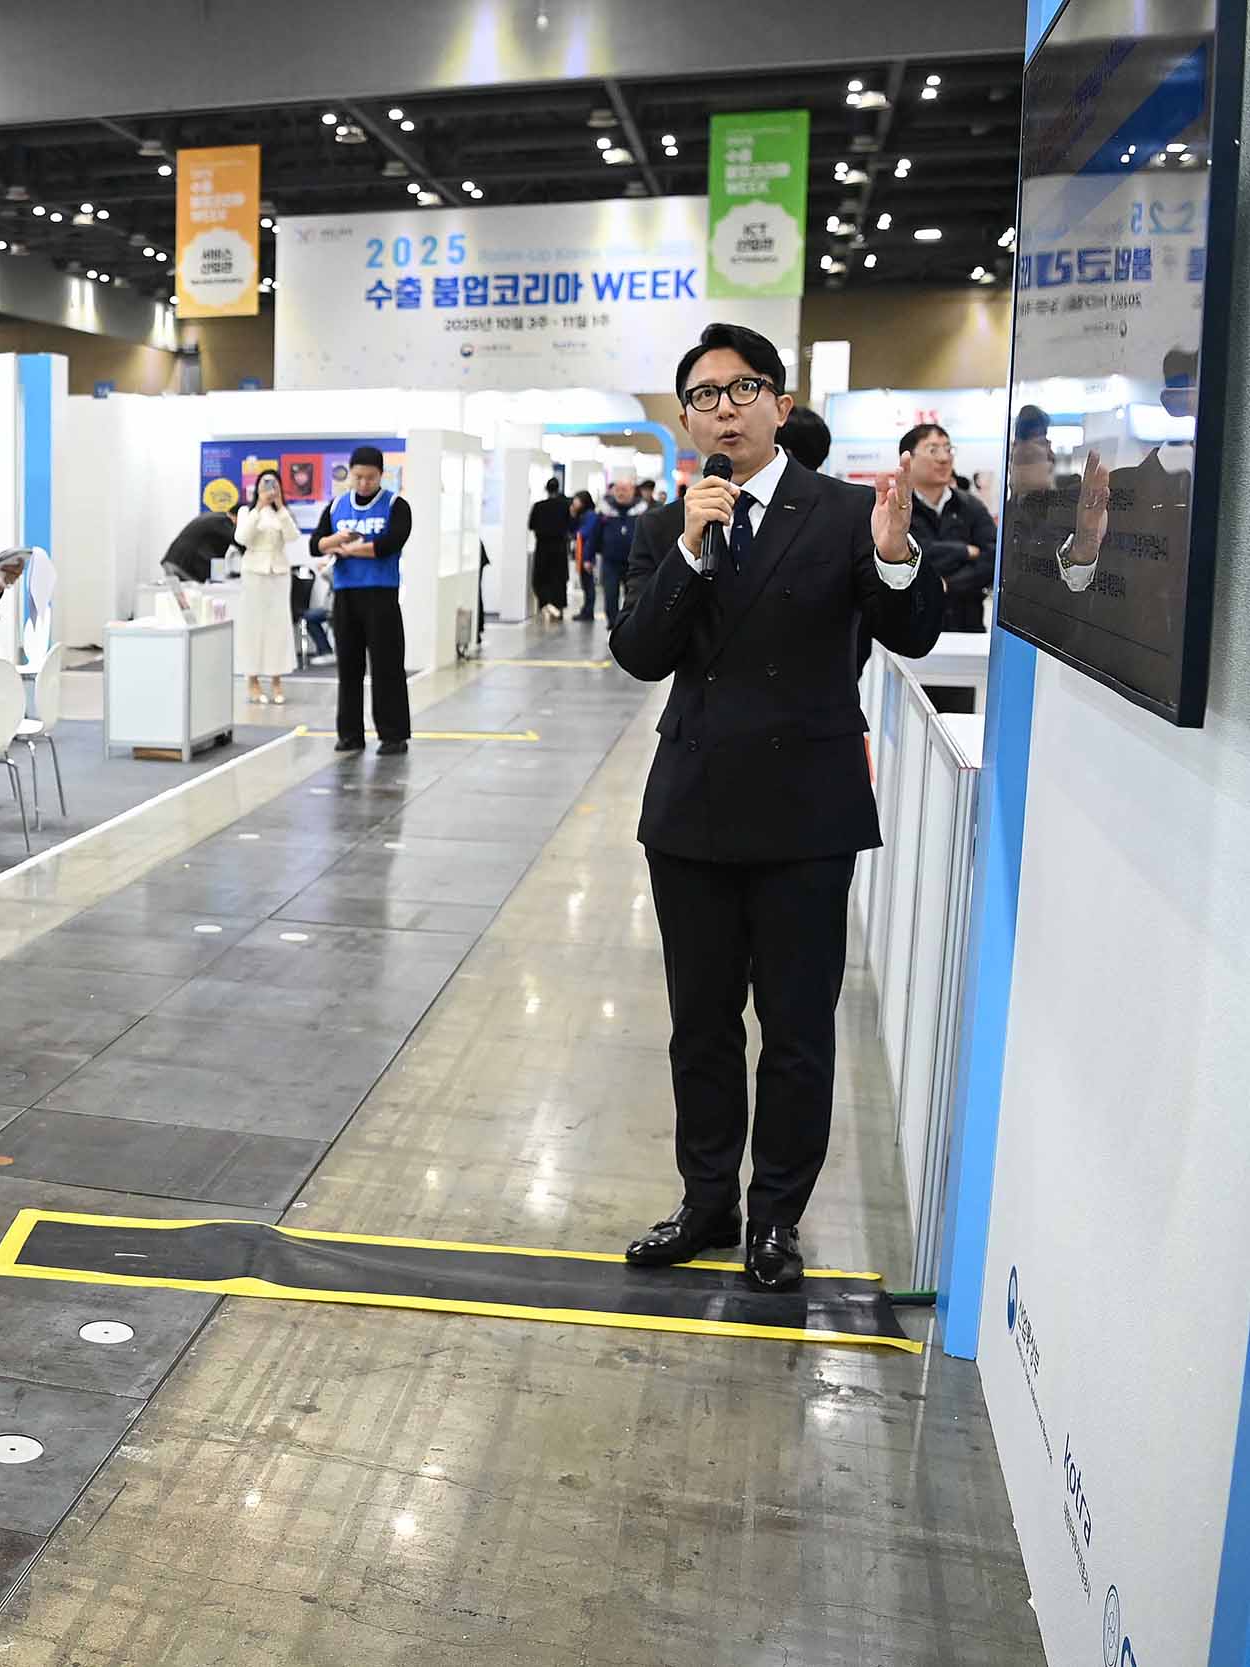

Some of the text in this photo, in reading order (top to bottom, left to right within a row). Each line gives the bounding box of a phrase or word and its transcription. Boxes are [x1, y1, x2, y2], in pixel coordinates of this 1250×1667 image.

[365, 234, 467, 269] 2025
[364, 267, 698, 310] 수출 붐업코리아 WEEK
[336, 517, 385, 535] STAFF
[1063, 1432, 1092, 1548] kotra
